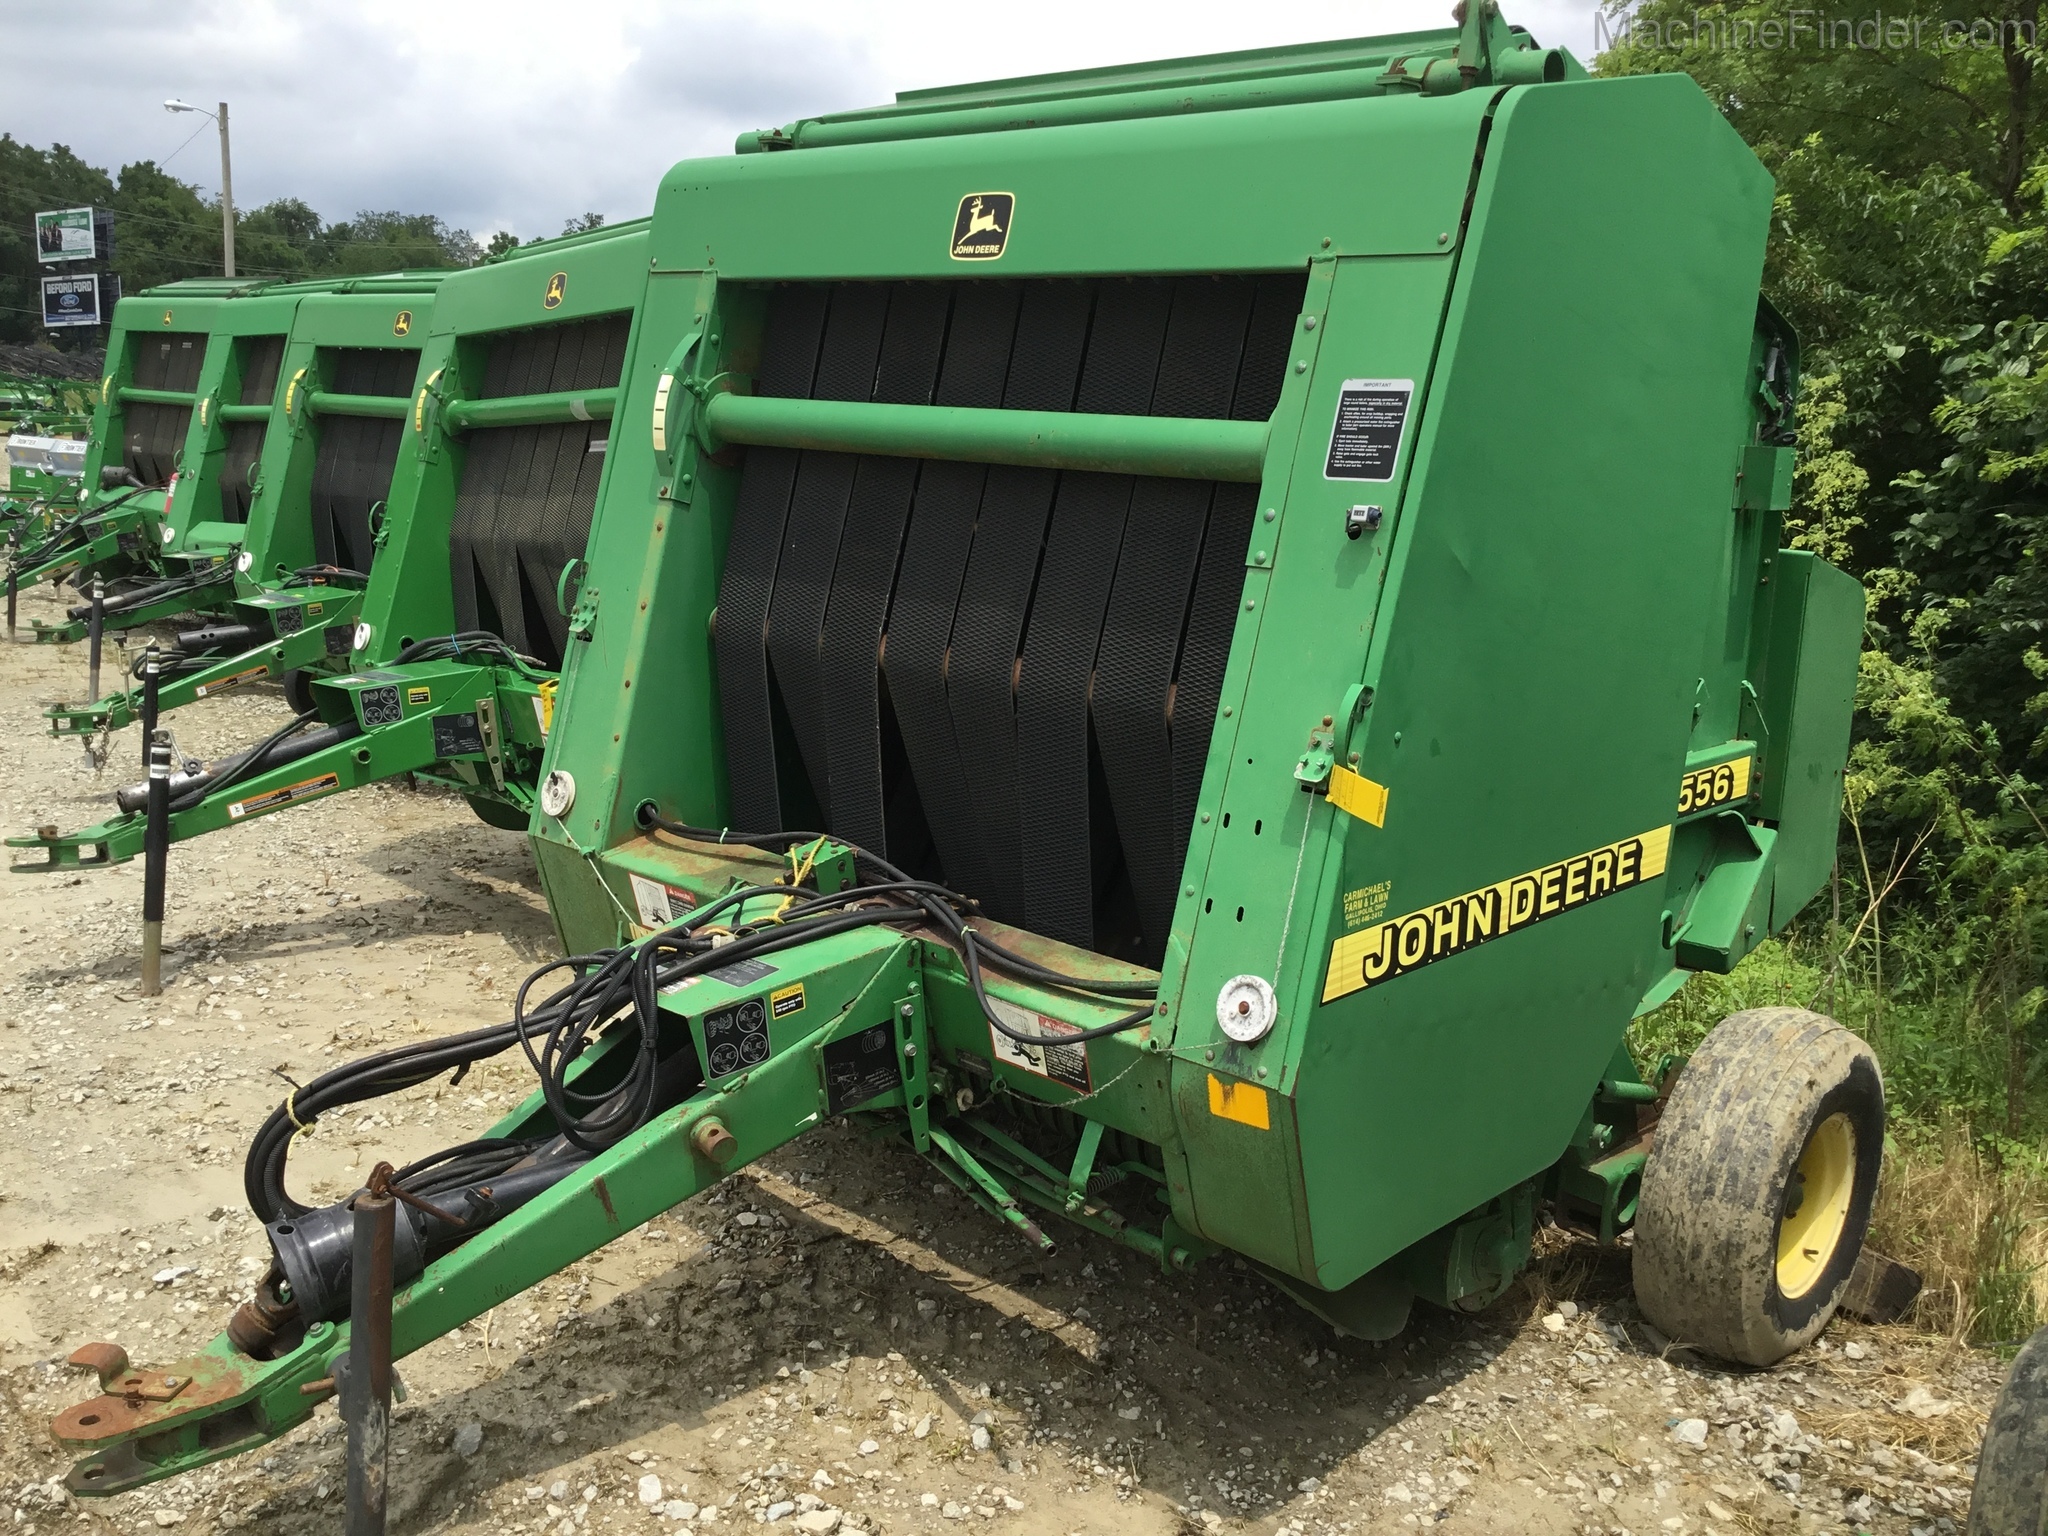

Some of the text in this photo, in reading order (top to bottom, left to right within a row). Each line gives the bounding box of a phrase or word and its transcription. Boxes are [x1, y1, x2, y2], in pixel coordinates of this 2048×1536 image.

[954, 244, 1000, 254] JOHN DEERE
[73, 280, 93, 293] FORD
[1677, 766, 1731, 813] 556
[1343, 880, 1391, 903] CARMICHAEL'S
[1345, 899, 1363, 914] FARM
[1370, 891, 1388, 905] LAWN
[1364, 841, 1641, 982] JOHN DEERE
[778, 986, 802, 999] CAUTION
